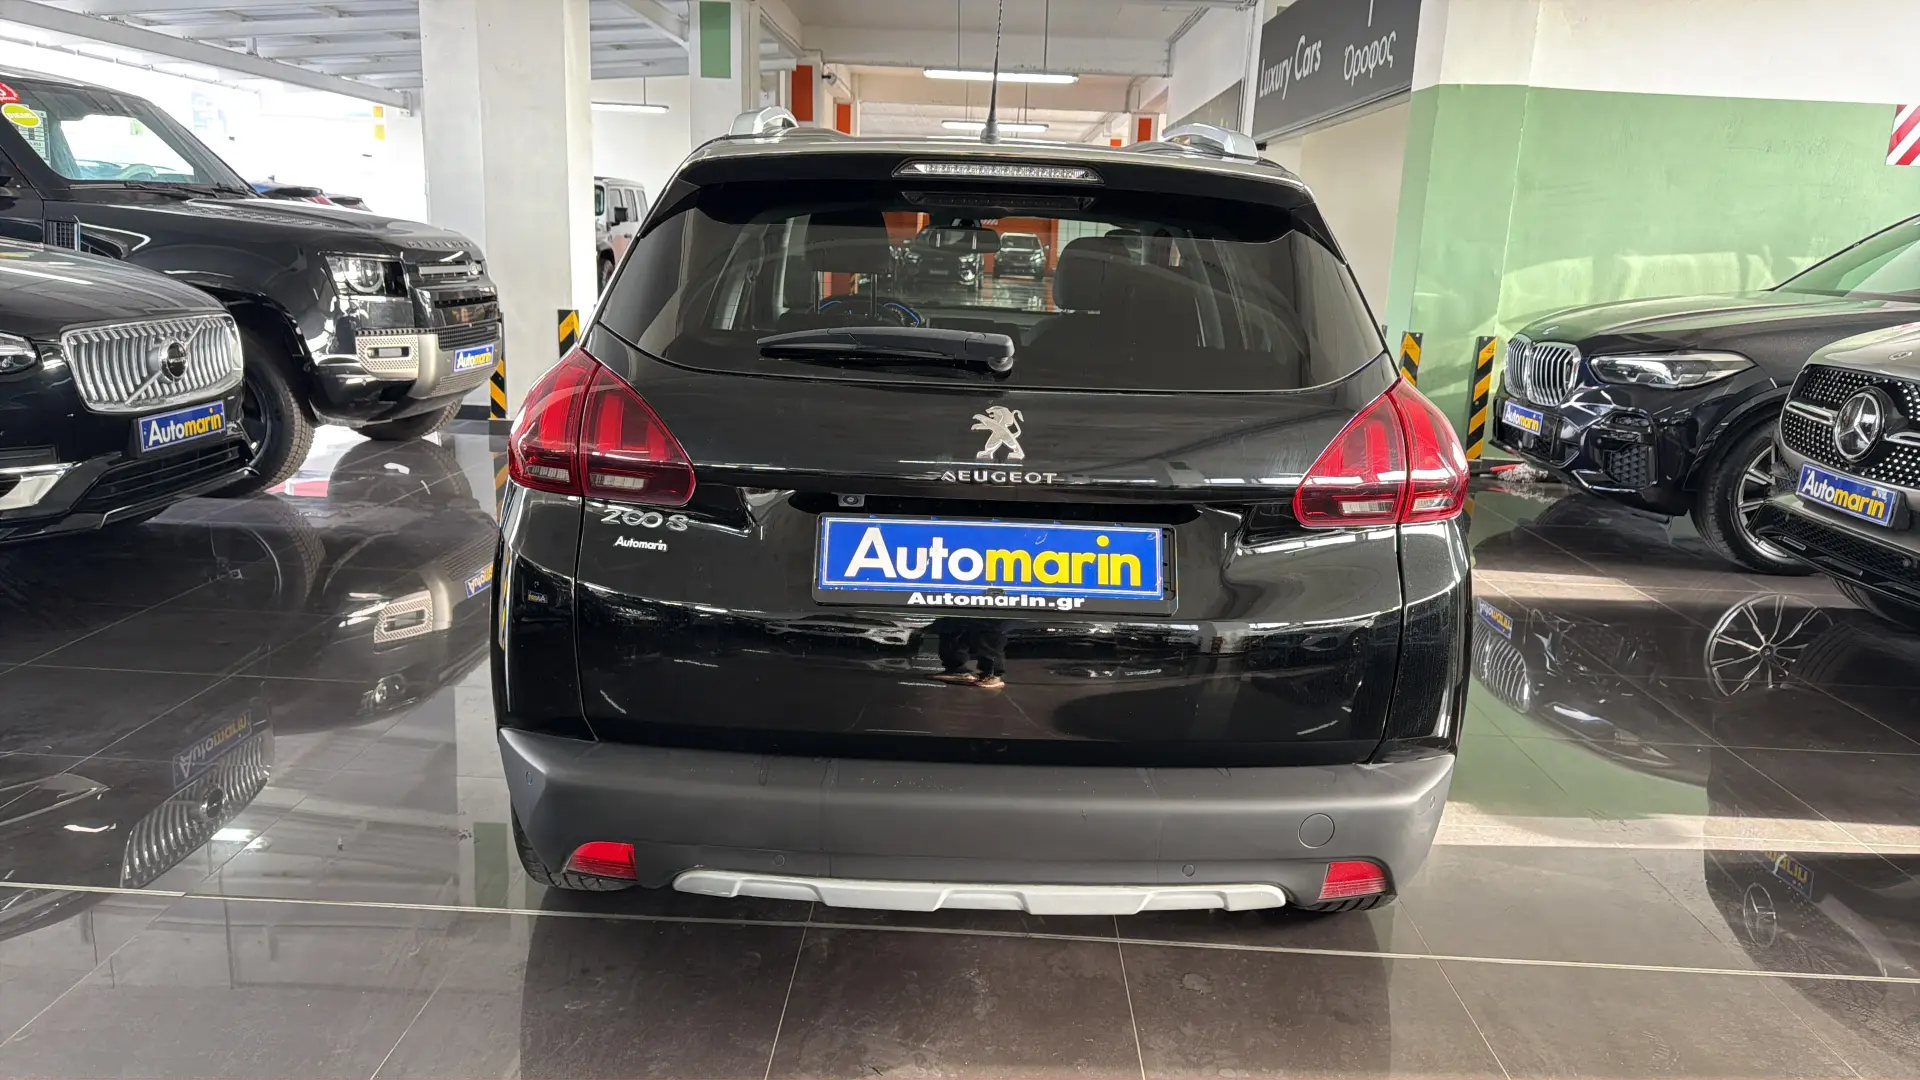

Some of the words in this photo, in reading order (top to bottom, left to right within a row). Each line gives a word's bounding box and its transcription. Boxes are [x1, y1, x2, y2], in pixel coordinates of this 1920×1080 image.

[1259, 56, 1293, 100] Luxury
[1294, 35, 1322, 81] Cars
[457, 347, 492, 369] Automarin
[148, 407, 222, 446] Automarin
[1504, 406, 1540, 432] Automarin
[1802, 470, 1885, 518] Automarin
[613, 536, 668, 552] Automarin
[844, 527, 1141, 586] Automarin
[907, 591, 1085, 611] Automarin.gr
